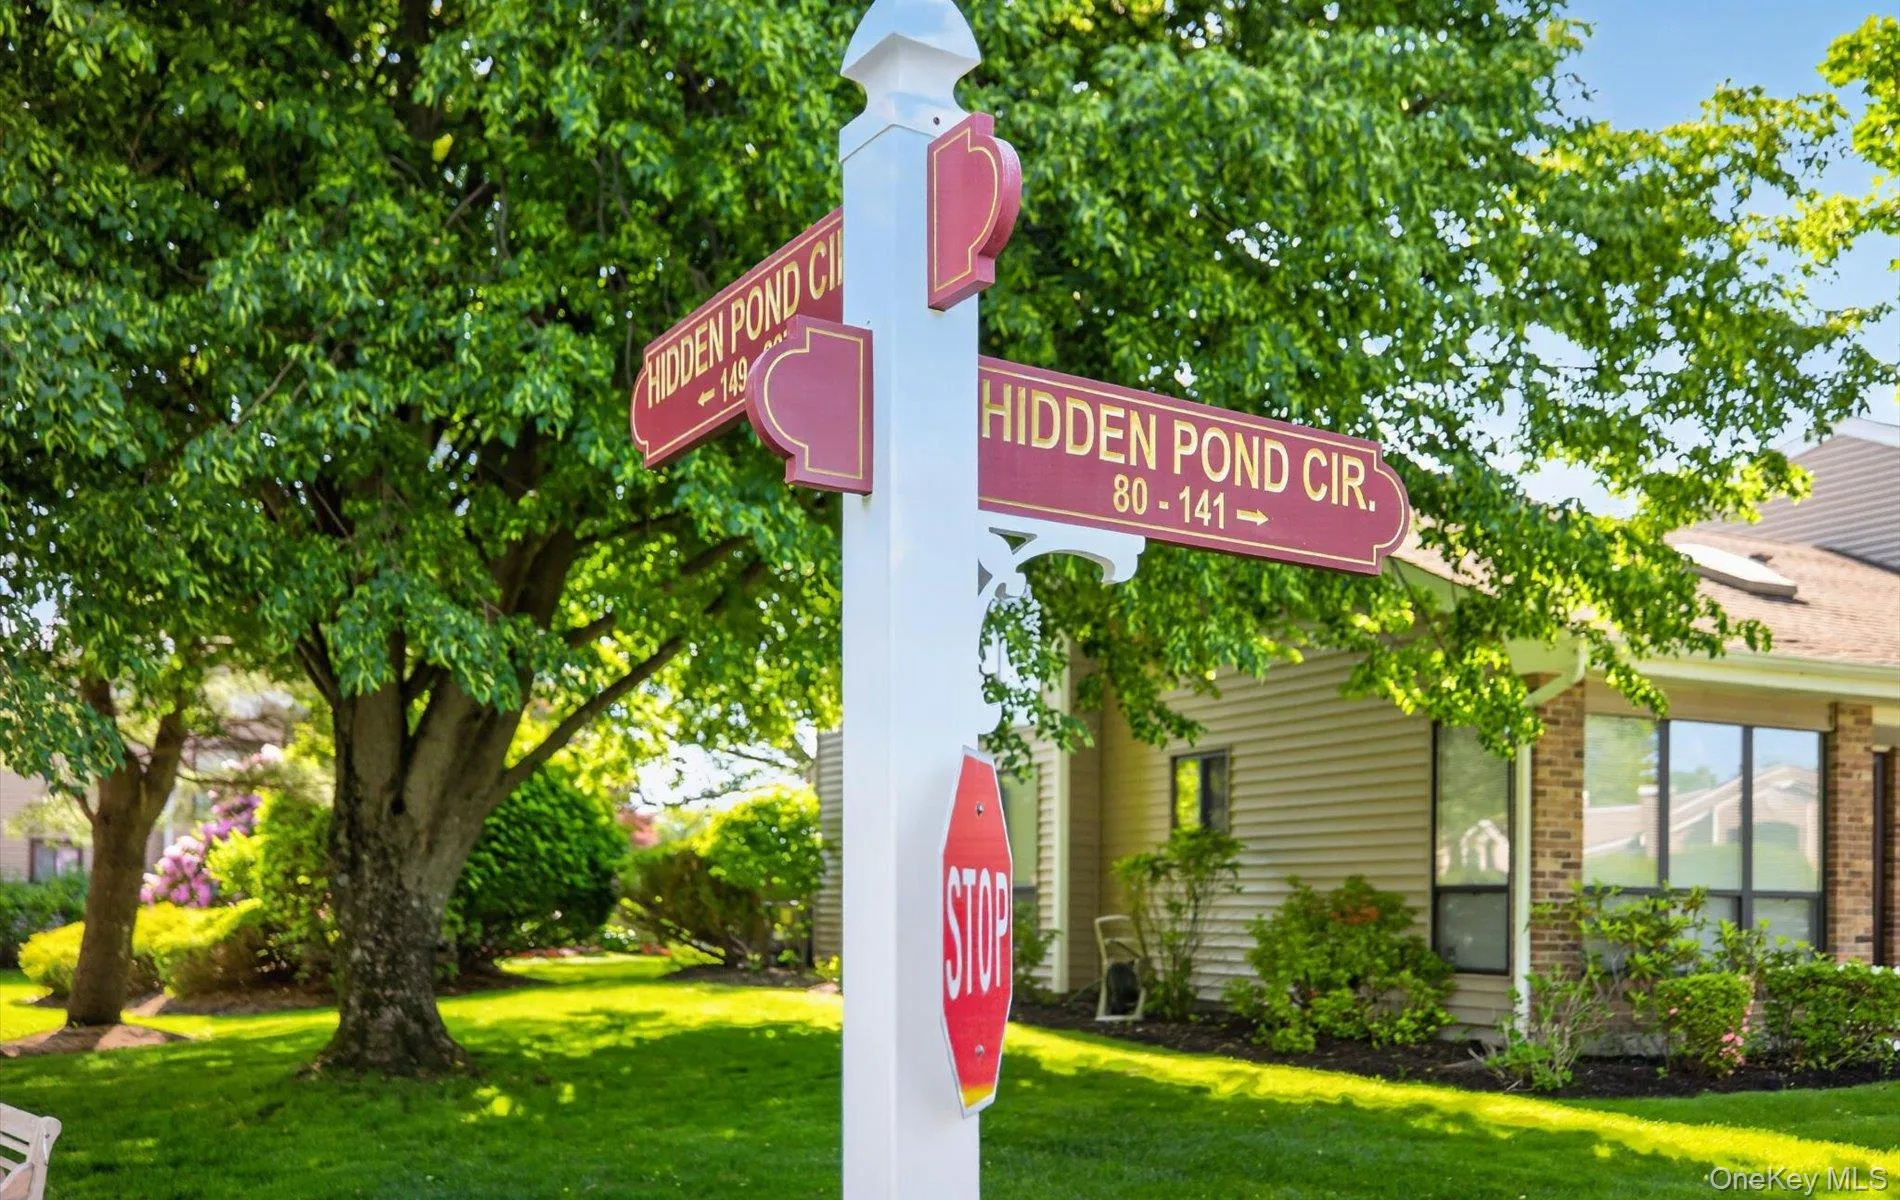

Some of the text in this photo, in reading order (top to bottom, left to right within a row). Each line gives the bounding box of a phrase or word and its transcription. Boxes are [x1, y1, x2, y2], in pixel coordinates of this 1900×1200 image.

[647, 310, 724, 409] HIDDEN
[731, 260, 801, 355] POND
[720, 355, 748, 403] 149
[982, 378, 1376, 513] HIDDEN POND CIR.
[1112, 473, 1226, 530] 80 - 141
[945, 865, 1009, 1000] STOP
